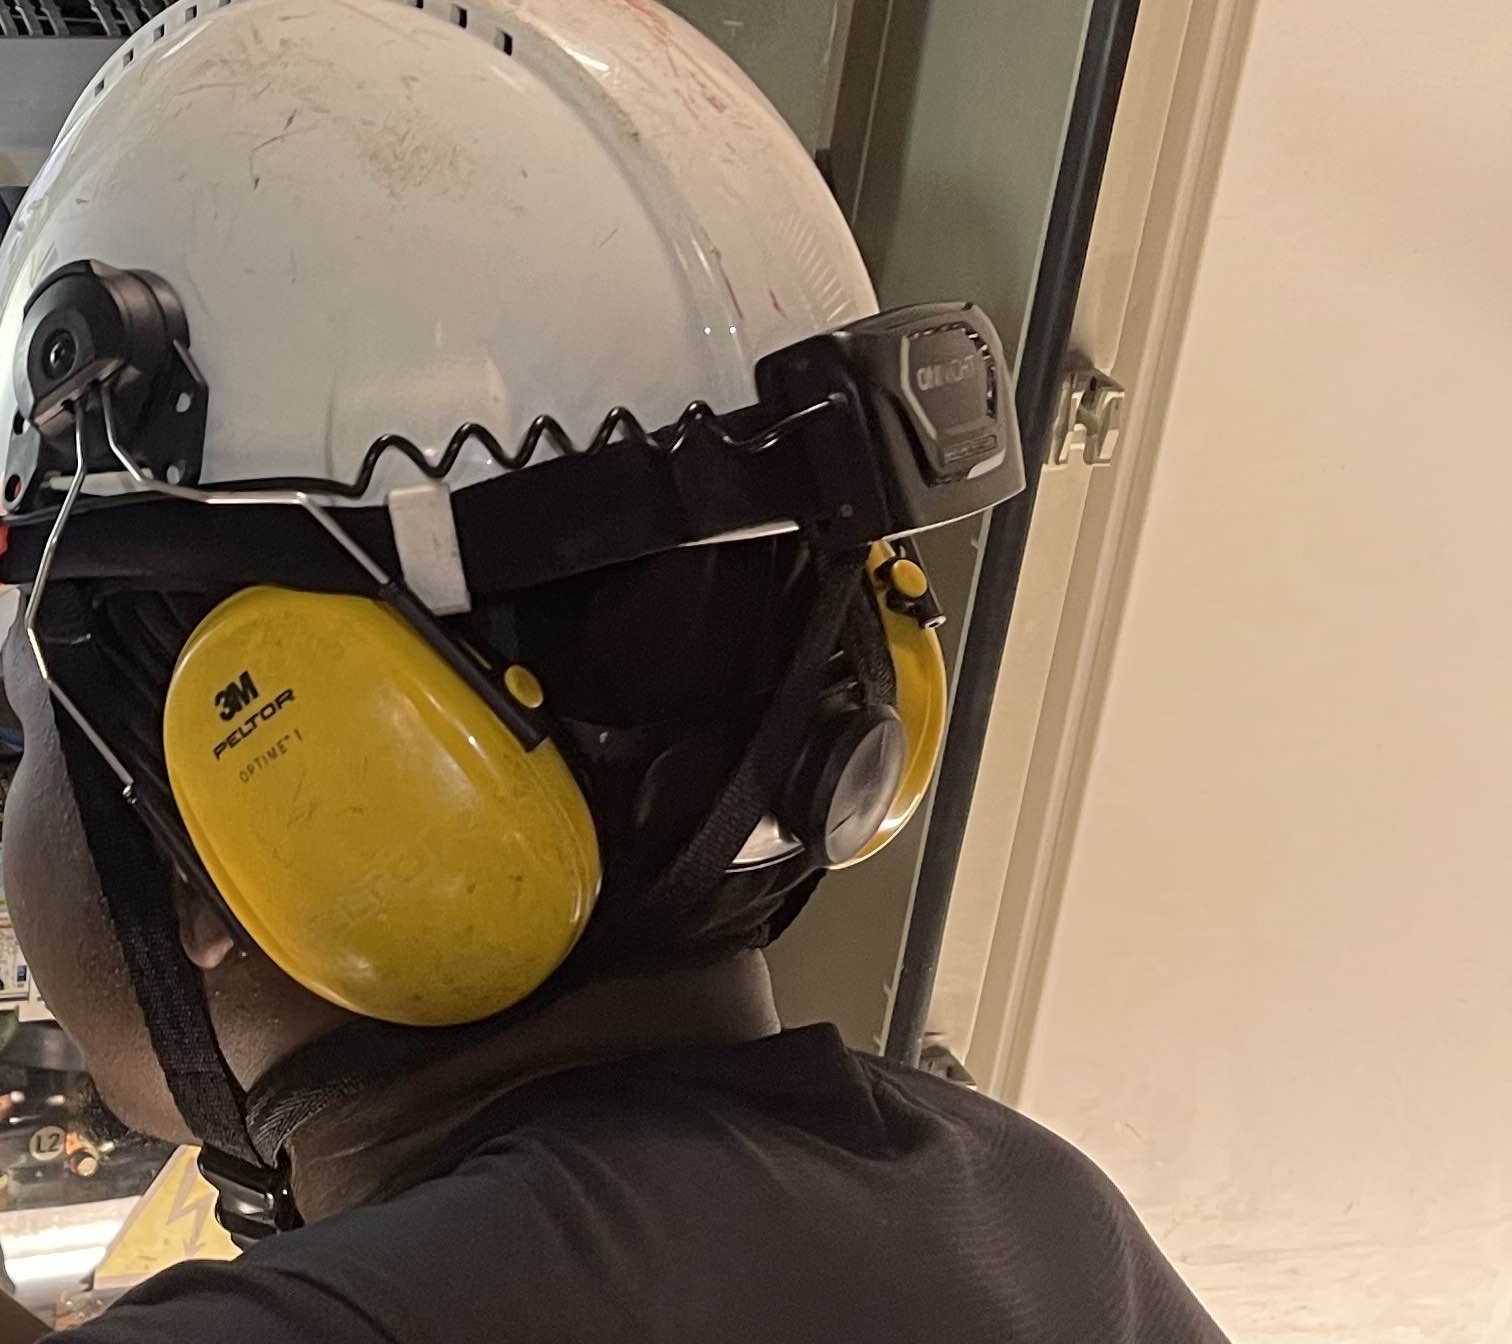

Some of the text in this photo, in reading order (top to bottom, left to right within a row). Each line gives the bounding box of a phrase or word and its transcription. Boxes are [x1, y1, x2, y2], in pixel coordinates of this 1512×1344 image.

[215, 670, 259, 721] 3M
[213, 688, 295, 760] PELTOR
[36, 1133, 60, 1153] L2
